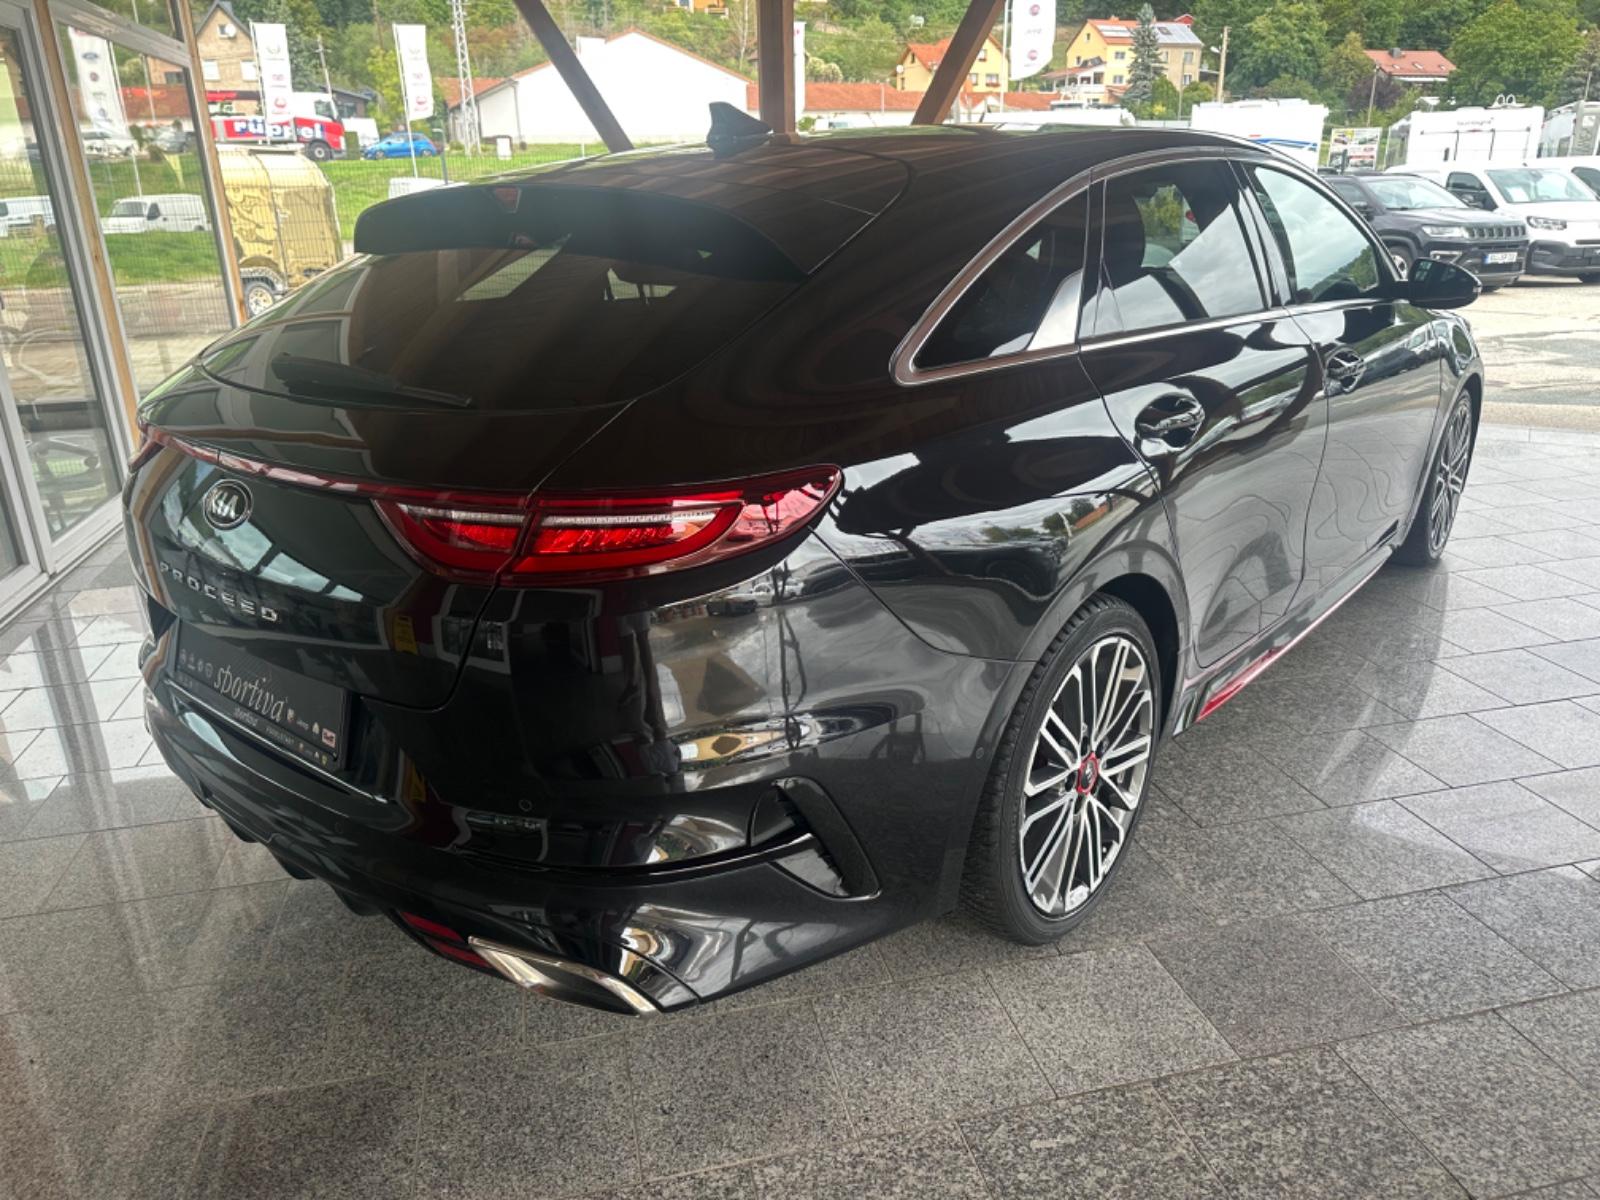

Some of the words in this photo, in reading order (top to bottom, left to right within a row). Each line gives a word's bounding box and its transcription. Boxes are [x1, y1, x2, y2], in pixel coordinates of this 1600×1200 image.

[209, 486, 239, 519] KIA
[159, 562, 278, 622] PROCEED
[214, 665, 284, 723] sportiva
